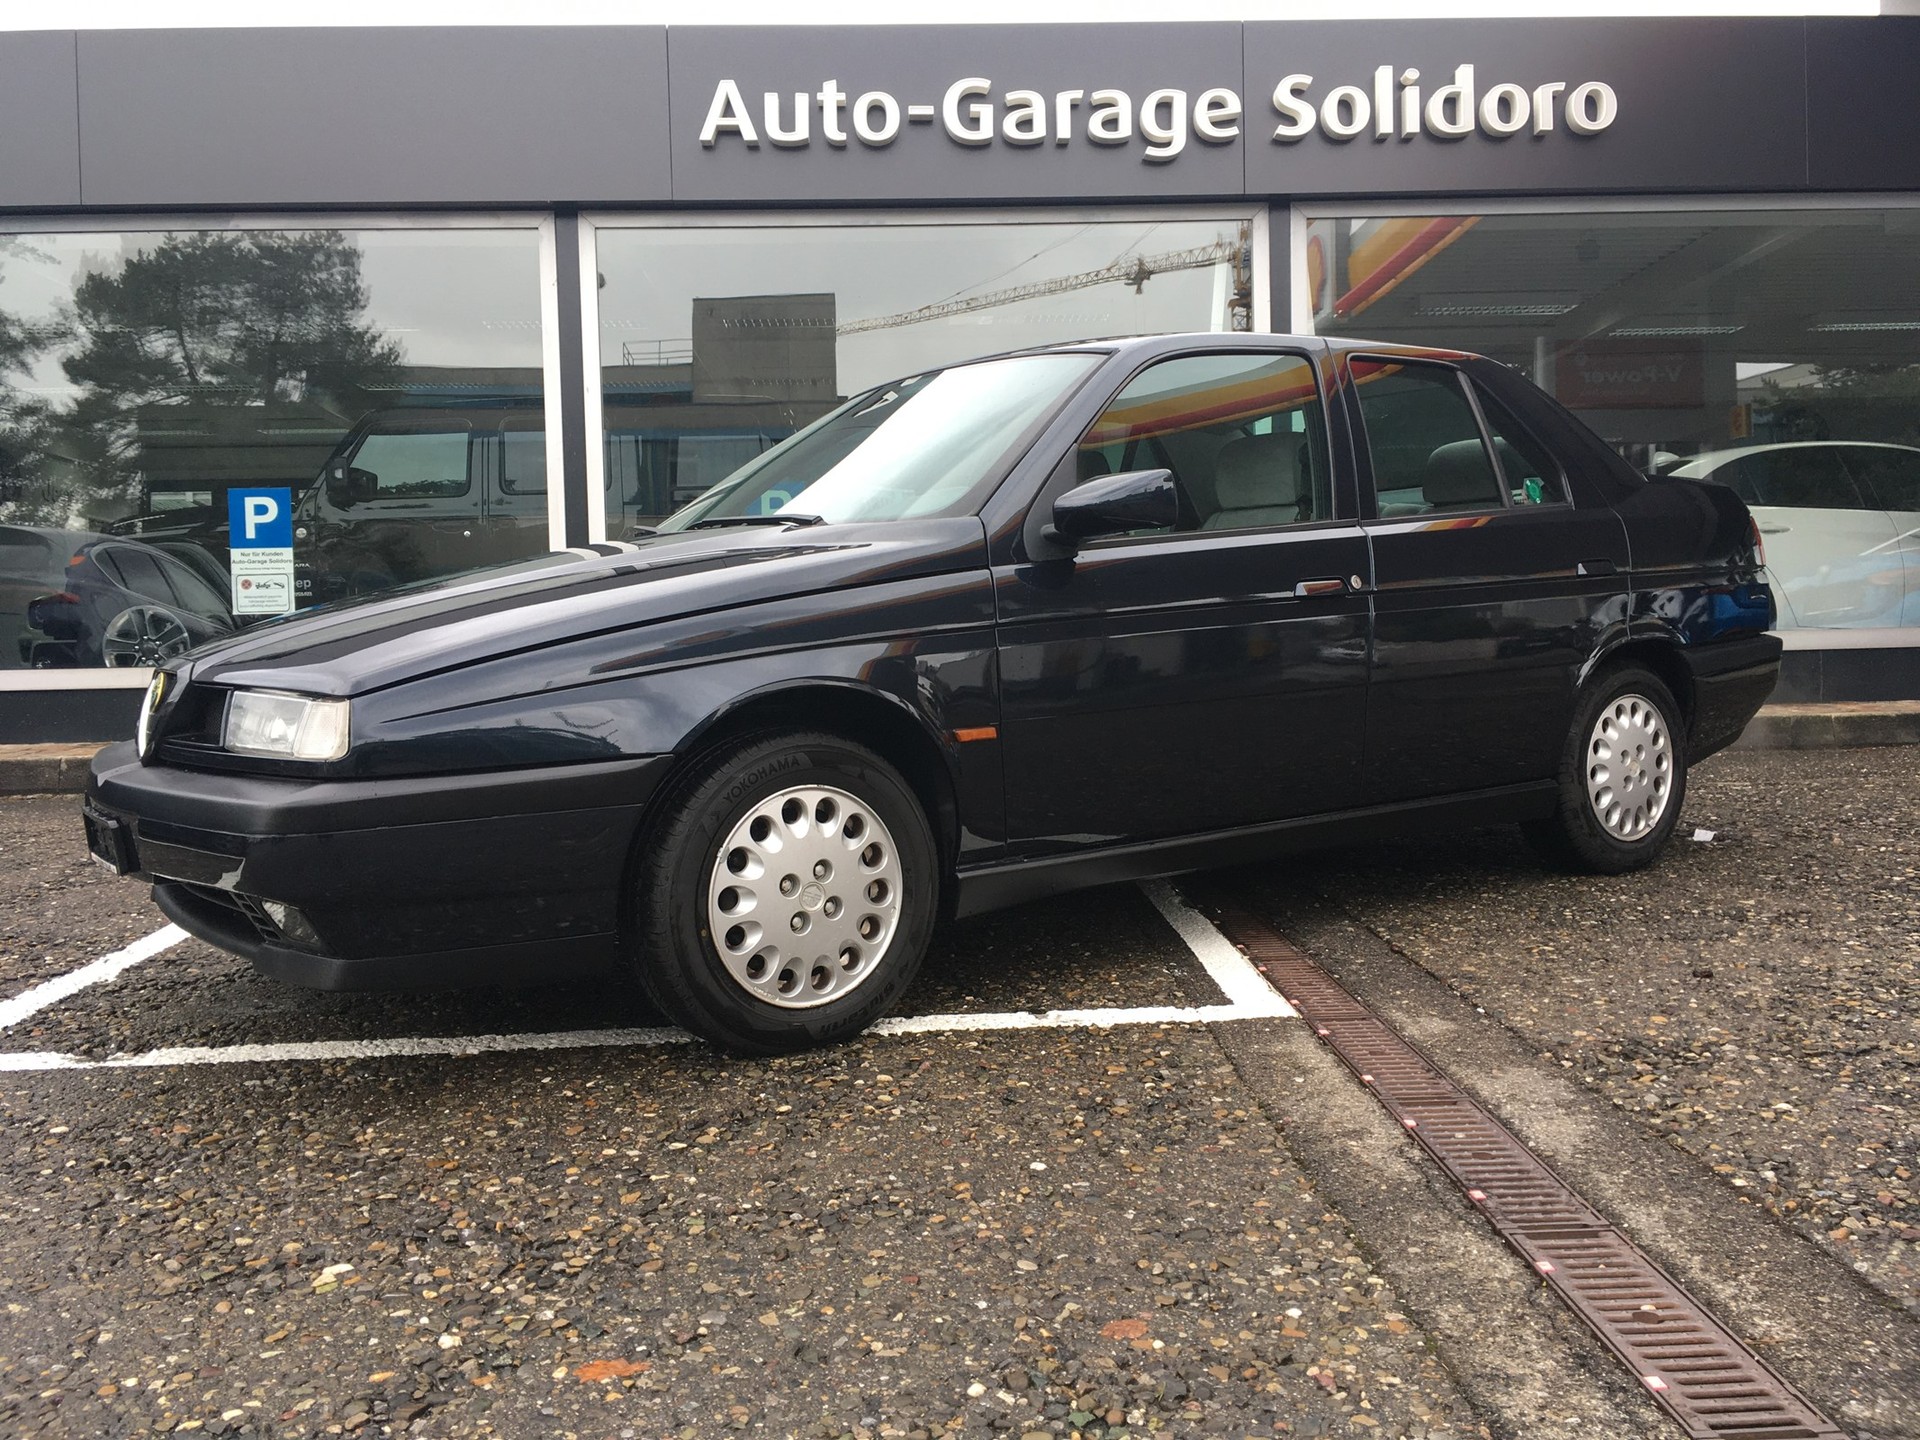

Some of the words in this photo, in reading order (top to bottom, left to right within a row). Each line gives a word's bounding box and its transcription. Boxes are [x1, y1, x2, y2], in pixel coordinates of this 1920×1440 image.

[699, 77, 1242, 162] Auto-Garage
[1272, 64, 1618, 142] Solidoro
[244, 496, 279, 539] P
[295, 579, 312, 590] ep
[723, 755, 801, 804] YOKOHAMA
